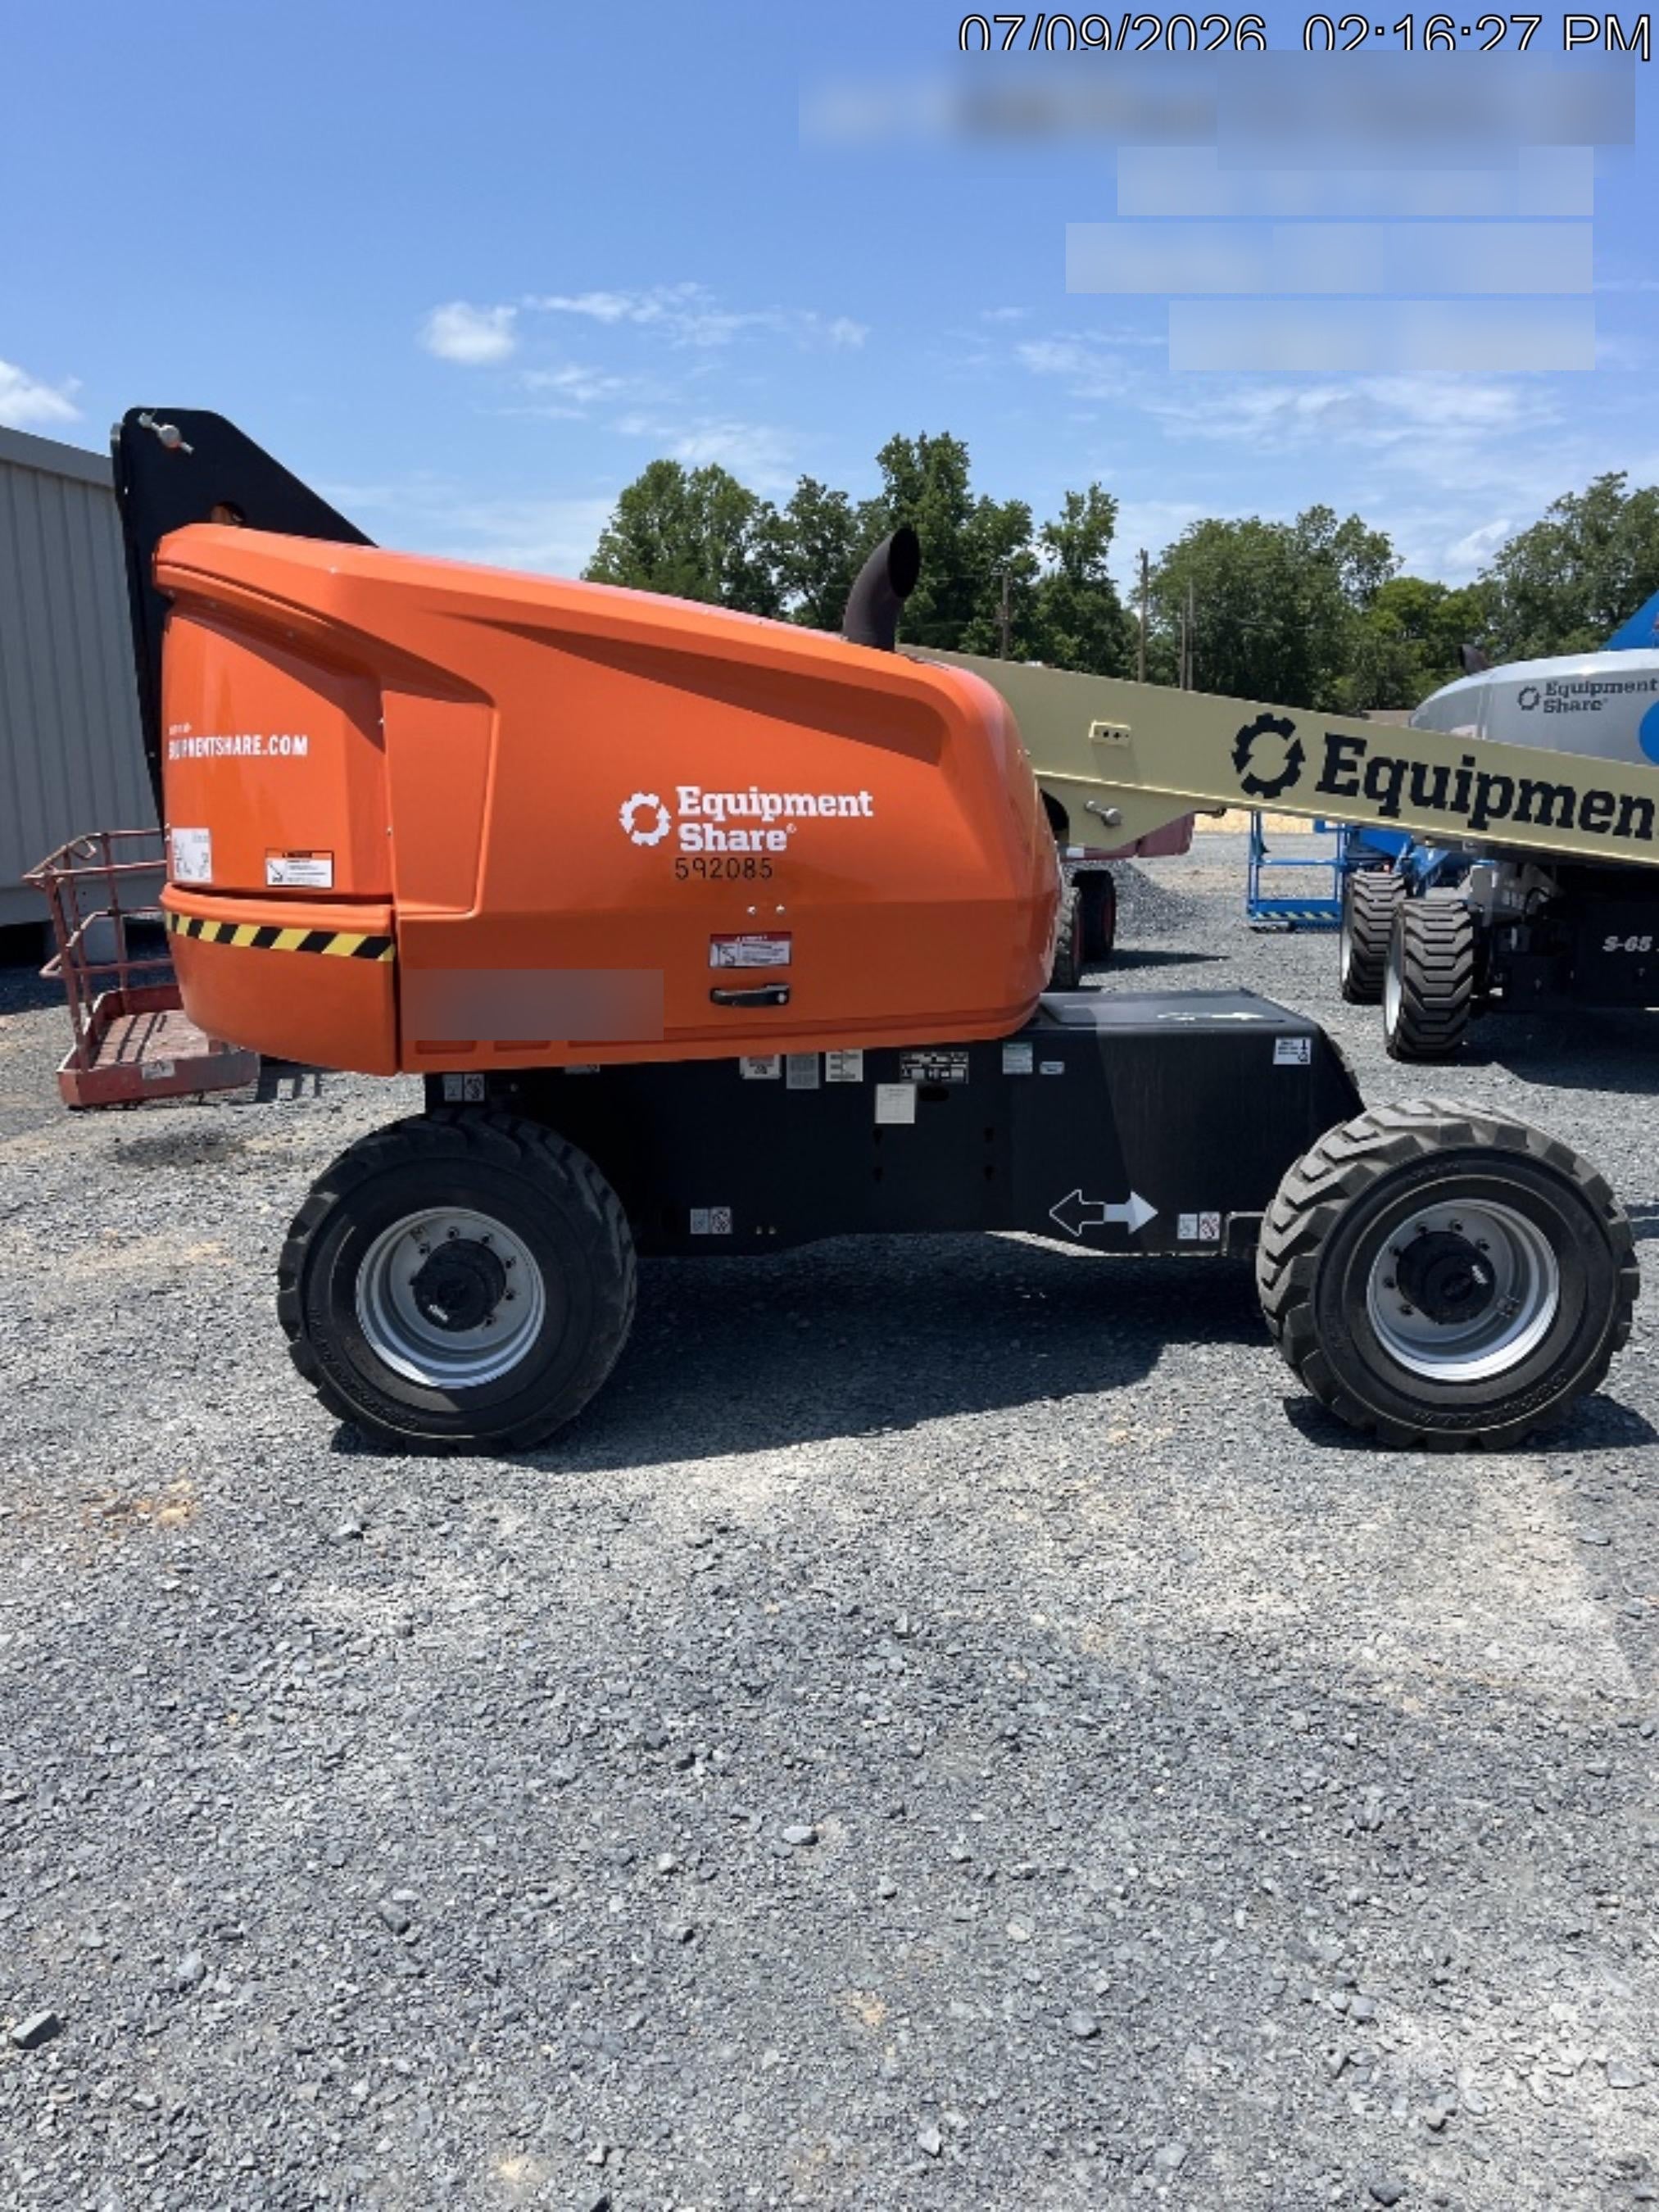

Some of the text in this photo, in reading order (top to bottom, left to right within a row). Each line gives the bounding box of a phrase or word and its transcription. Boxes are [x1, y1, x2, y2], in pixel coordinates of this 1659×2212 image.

[1545, 678, 1659, 698] Equipment
[169, 734, 308, 760] MENTSHARE.COM
[675, 786, 874, 822] Equipment
[674, 857, 773, 880] 592085
